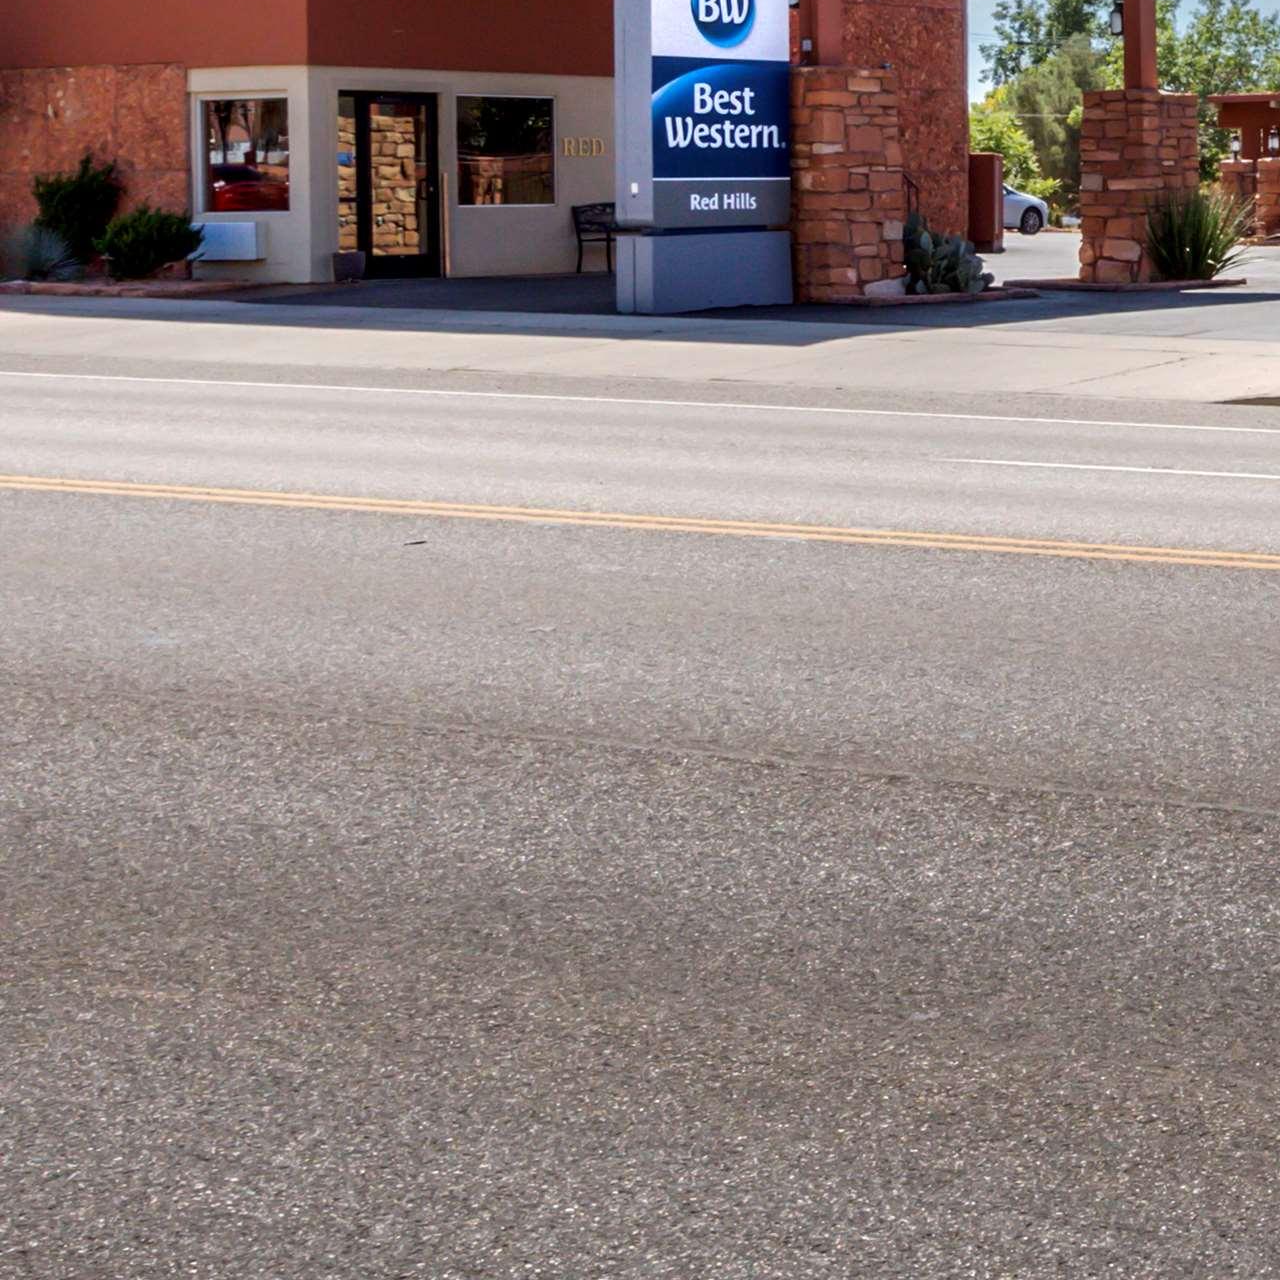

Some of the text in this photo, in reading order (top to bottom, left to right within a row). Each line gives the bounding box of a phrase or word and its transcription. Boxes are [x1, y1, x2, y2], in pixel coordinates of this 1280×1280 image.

[693, 82, 755, 115] Best
[665, 116, 780, 149] Western
[562, 136, 605, 157] RED
[690, 192, 757, 210] Red Hills
